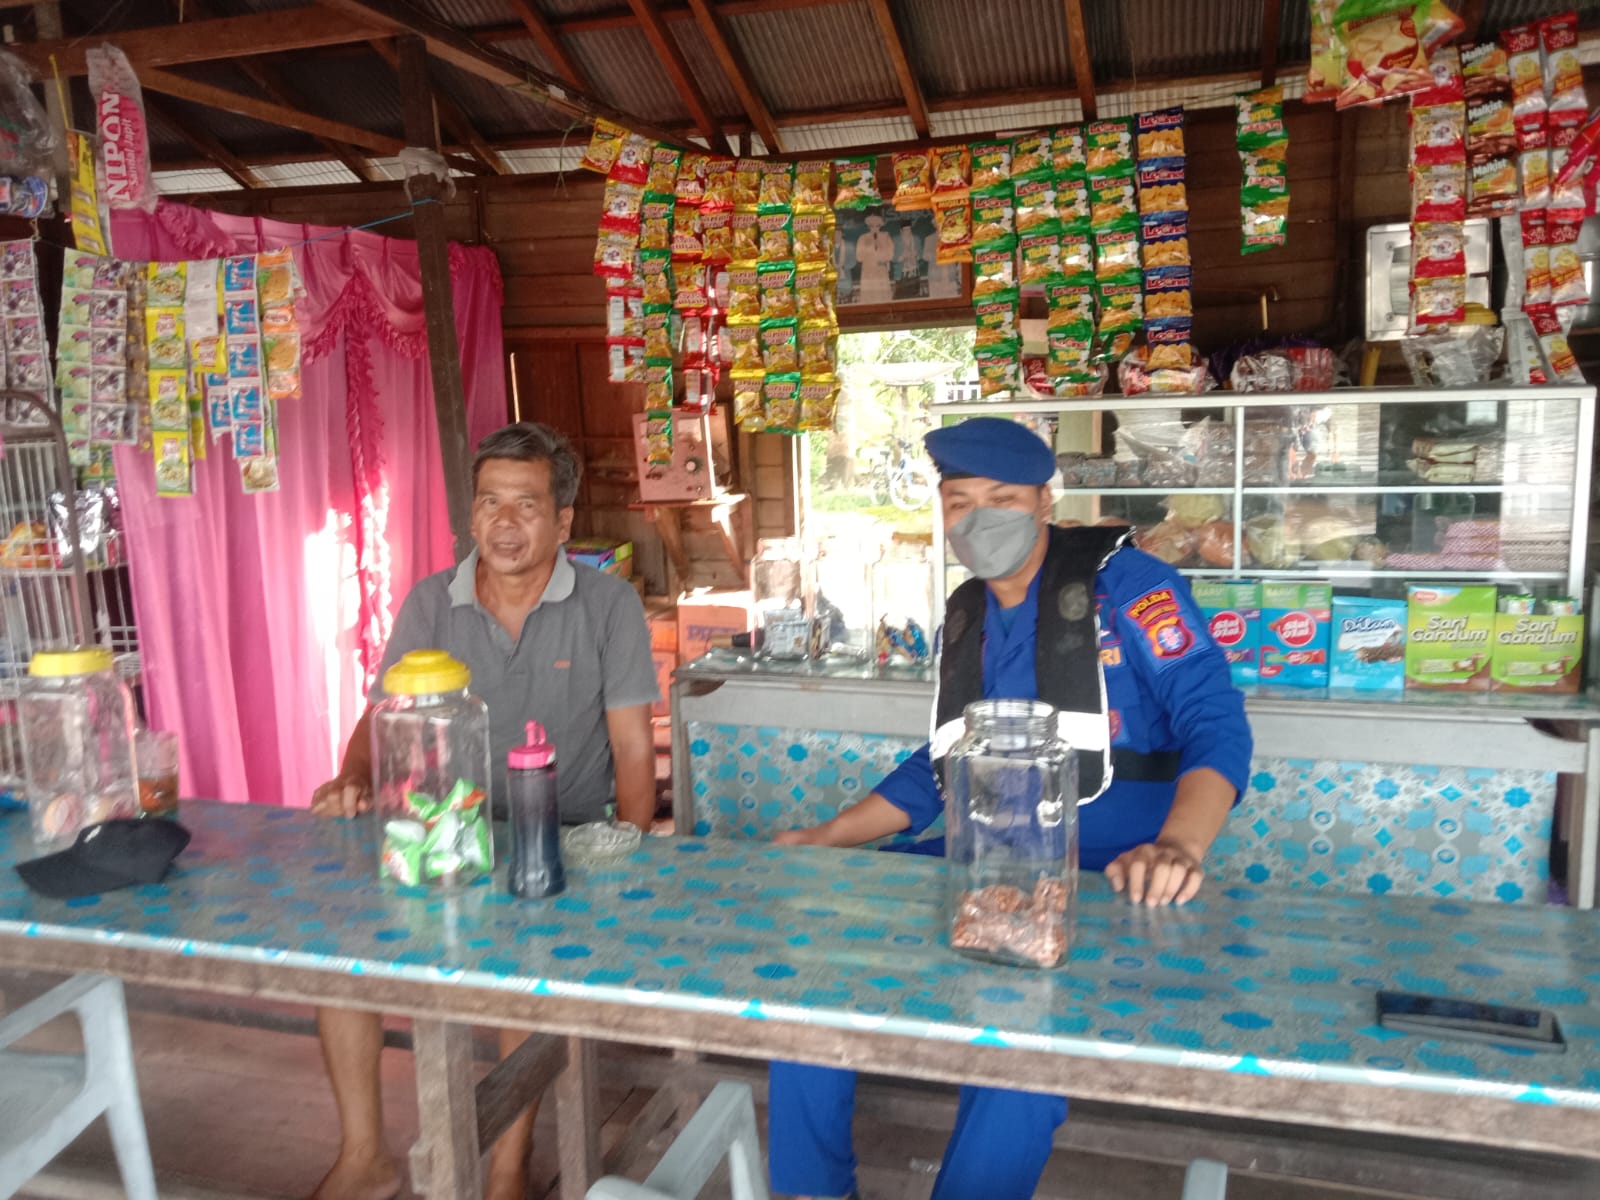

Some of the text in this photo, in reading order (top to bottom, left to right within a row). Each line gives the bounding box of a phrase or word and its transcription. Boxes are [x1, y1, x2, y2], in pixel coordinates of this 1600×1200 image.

[1461, 42, 1496, 63] Malkist
[1468, 100, 1503, 121] Malkist
[102, 91, 131, 202] NIPON
[1473, 158, 1508, 178] Malkist
[1129, 592, 1171, 618] POLDA
[1426, 615, 1469, 631] Sari
[1515, 617, 1558, 633] Sari
[1410, 629, 1488, 644] Gandum
[1498, 631, 1577, 646] Gandum
